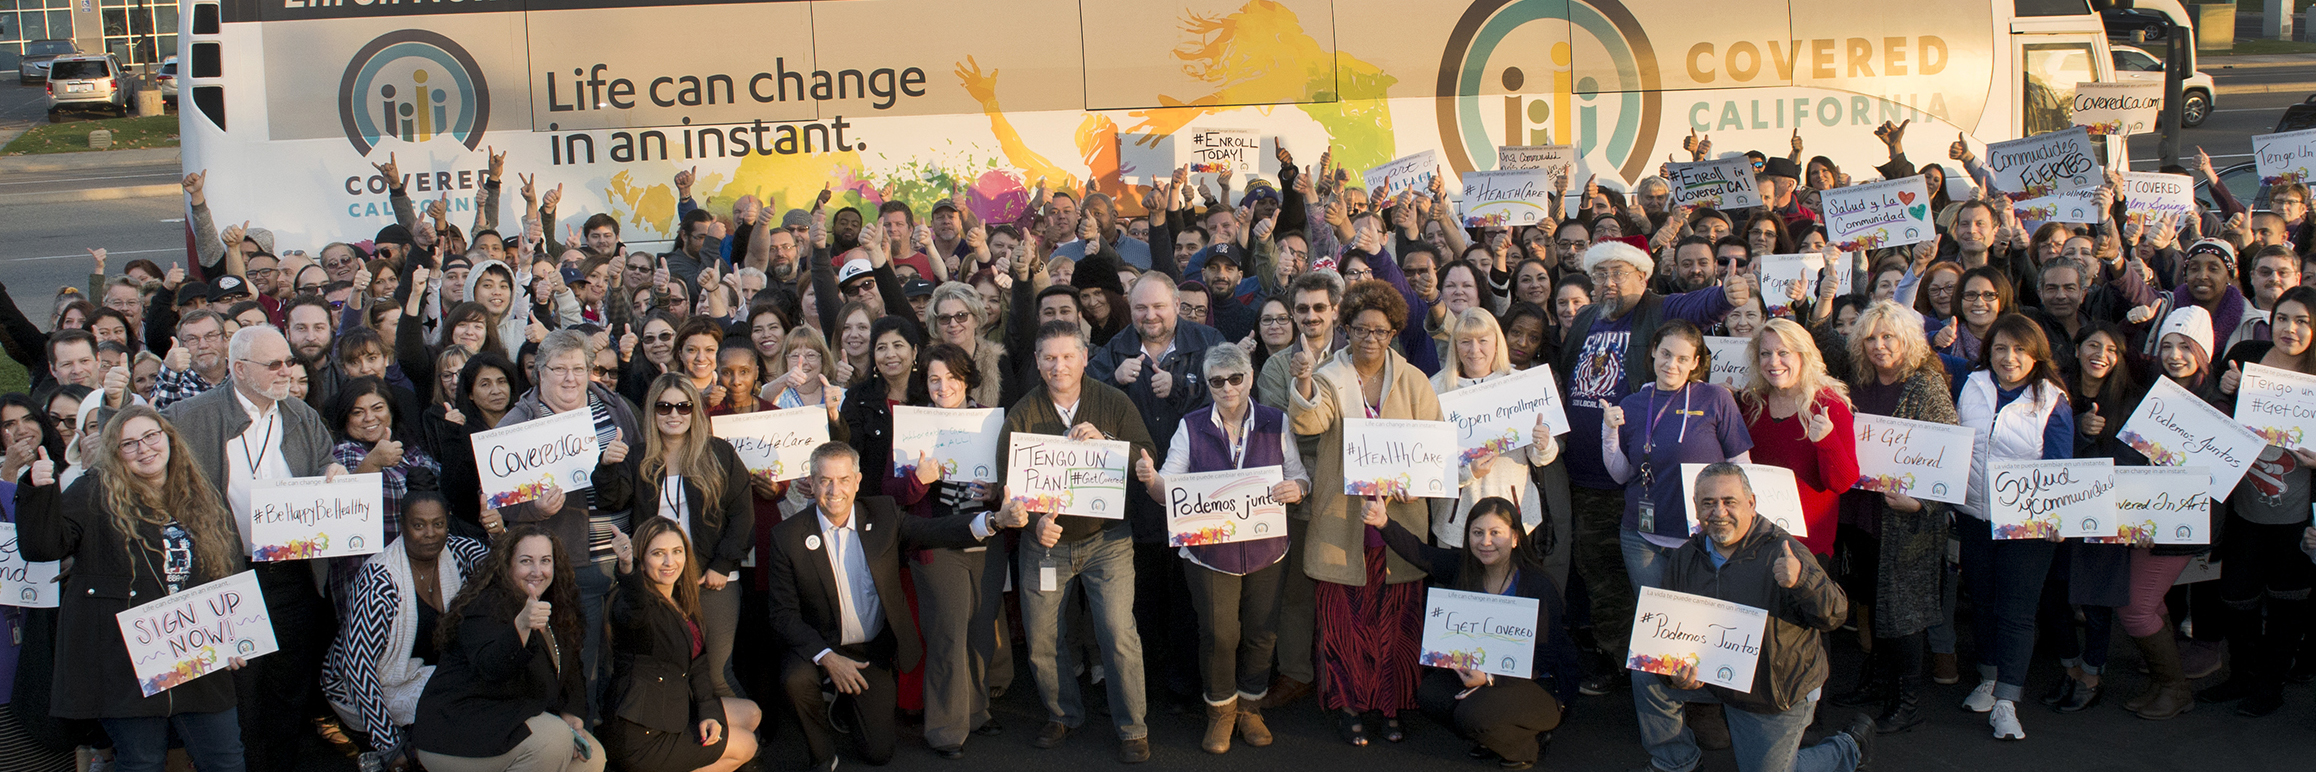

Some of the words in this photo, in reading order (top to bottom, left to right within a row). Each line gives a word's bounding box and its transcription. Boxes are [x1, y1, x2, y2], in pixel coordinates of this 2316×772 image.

[1686, 36, 1948, 83] COVERED
[547, 64, 635, 112] Life
[650, 73, 734, 108] can
[749, 57, 926, 110] change
[1689, 92, 1950, 132] CALIFORNIA
[550, 123, 595, 165] in
[610, 129, 666, 162] an
[682, 116, 867, 159] instant.
[1193, 132, 1258, 148] #ENROLL
[1194, 148, 1243, 162] TODAY!
[1388, 162, 1419, 178] art
[1423, 156, 1433, 167] of
[2255, 143, 2295, 169] Tengo
[2020, 153, 2092, 194] FUERTES
[1675, 184, 1724, 202] Covered
[2136, 180, 2181, 194] COVERED
[1829, 198, 1866, 215] Salud
[1870, 201, 1880, 213] y
[2301, 388, 2314, 396] un
[1448, 410, 1491, 439] #open
[1496, 387, 1552, 419] enrollment
[2147, 396, 2194, 441] Podemos
[2182, 437, 2240, 468] Juntos
[1086, 450, 1109, 468] UN
[1894, 445, 1945, 469] Covered
[1024, 468, 1069, 493] PLAN!
[1995, 467, 2080, 506] Salud
[1171, 487, 1236, 518] Podemos
[2115, 498, 2151, 510] vered
[133, 602, 197, 645] SIGN
[208, 592, 240, 617] UP
[1483, 617, 1533, 638] COVERED
[168, 620, 236, 658] NOW!
[1709, 624, 1759, 656] Juntos
